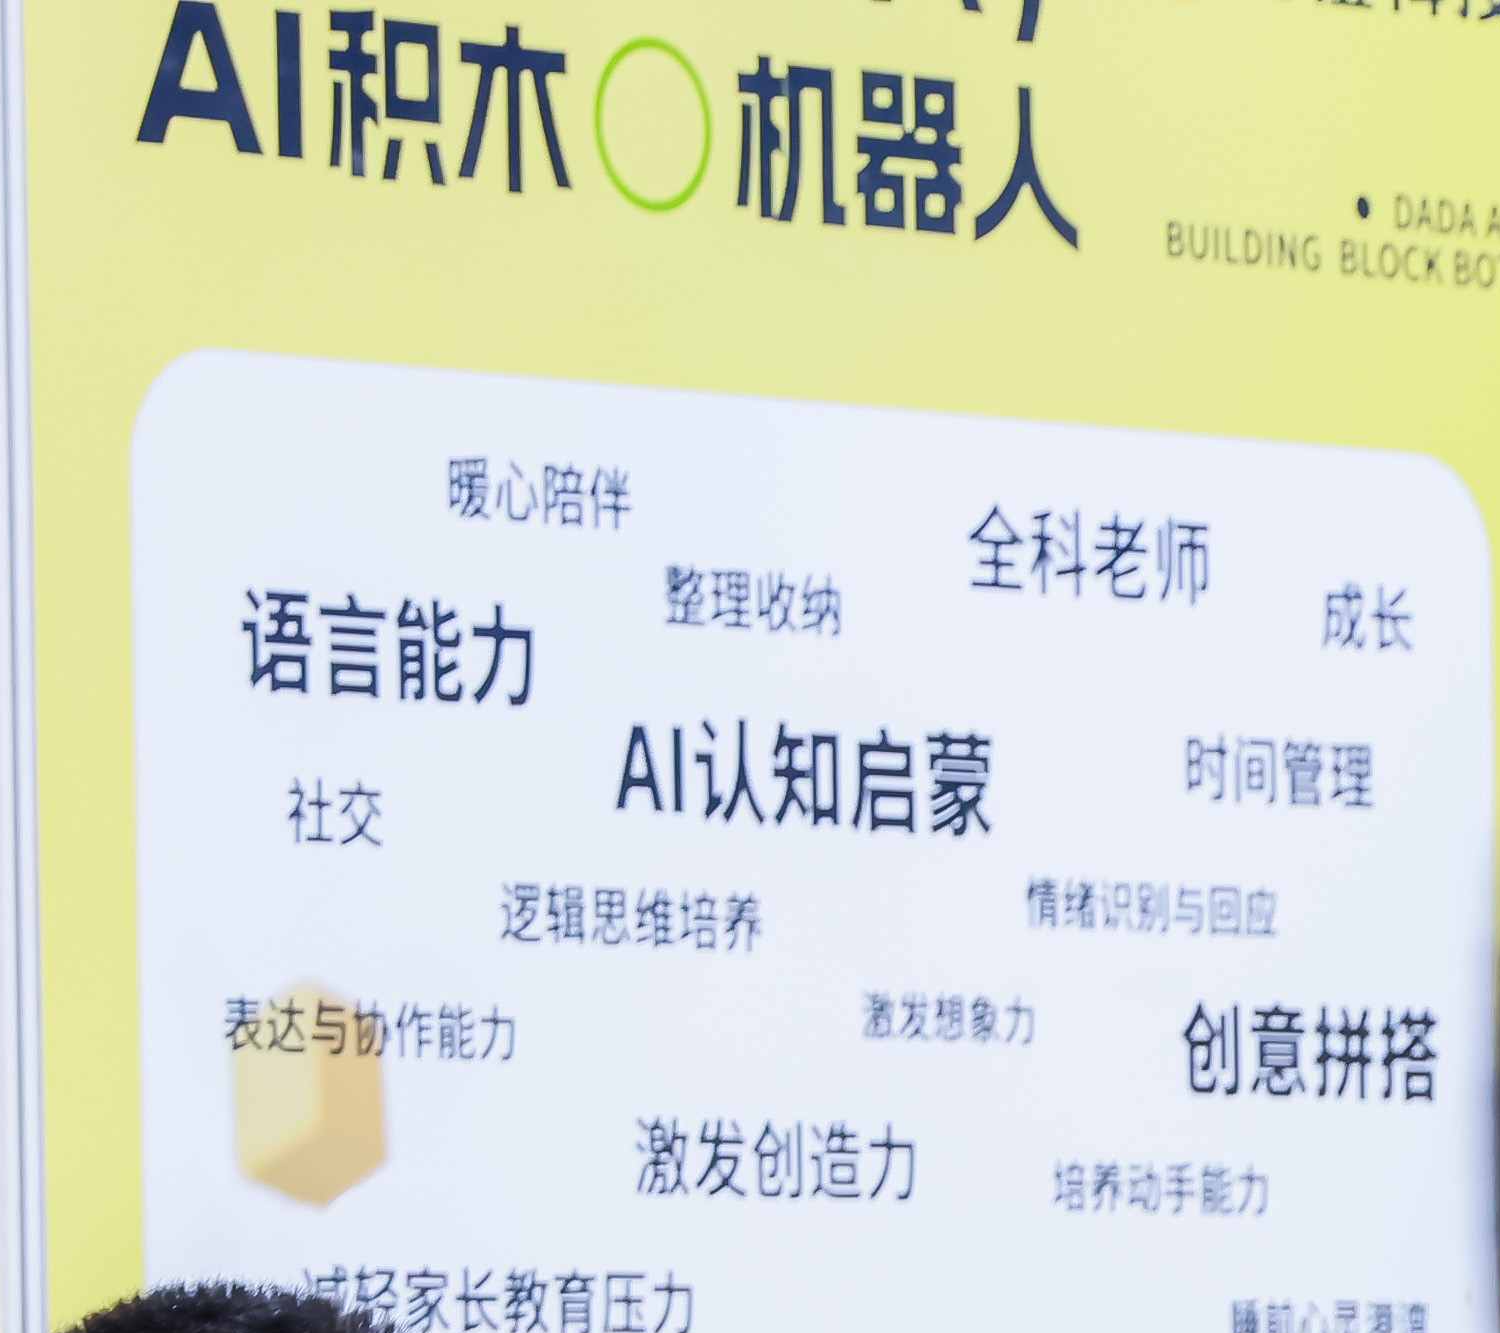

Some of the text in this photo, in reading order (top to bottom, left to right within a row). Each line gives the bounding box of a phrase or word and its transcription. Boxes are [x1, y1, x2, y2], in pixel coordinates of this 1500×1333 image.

[1394, 193, 1477, 236] DADA
[1166, 220, 1321, 272] BUILDING
[1339, 232, 1444, 283] BLOCK
[448, 458, 631, 528] 暖心陪伴
[969, 505, 1208, 604] 全科老师
[666, 565, 840, 636] 整理收纳
[1323, 584, 1411, 650] 成长
[242, 589, 532, 706] 语言能力
[616, 720, 990, 836] AI认知启蒙
[1186, 736, 1373, 808] 时间管理
[288, 779, 381, 846] 社交
[501, 884, 760, 951] 逻辑思维培养
[1026, 878, 1276, 937] 情绪识别与回应
[225, 997, 514, 1060] 表达与协作能力
[864, 993, 1034, 1045] 激发想象力
[1183, 1003, 1437, 1101] 创意拼搭
[637, 1118, 914, 1200] 激发创造力
[1054, 1162, 1268, 1215] 培养动手能力
